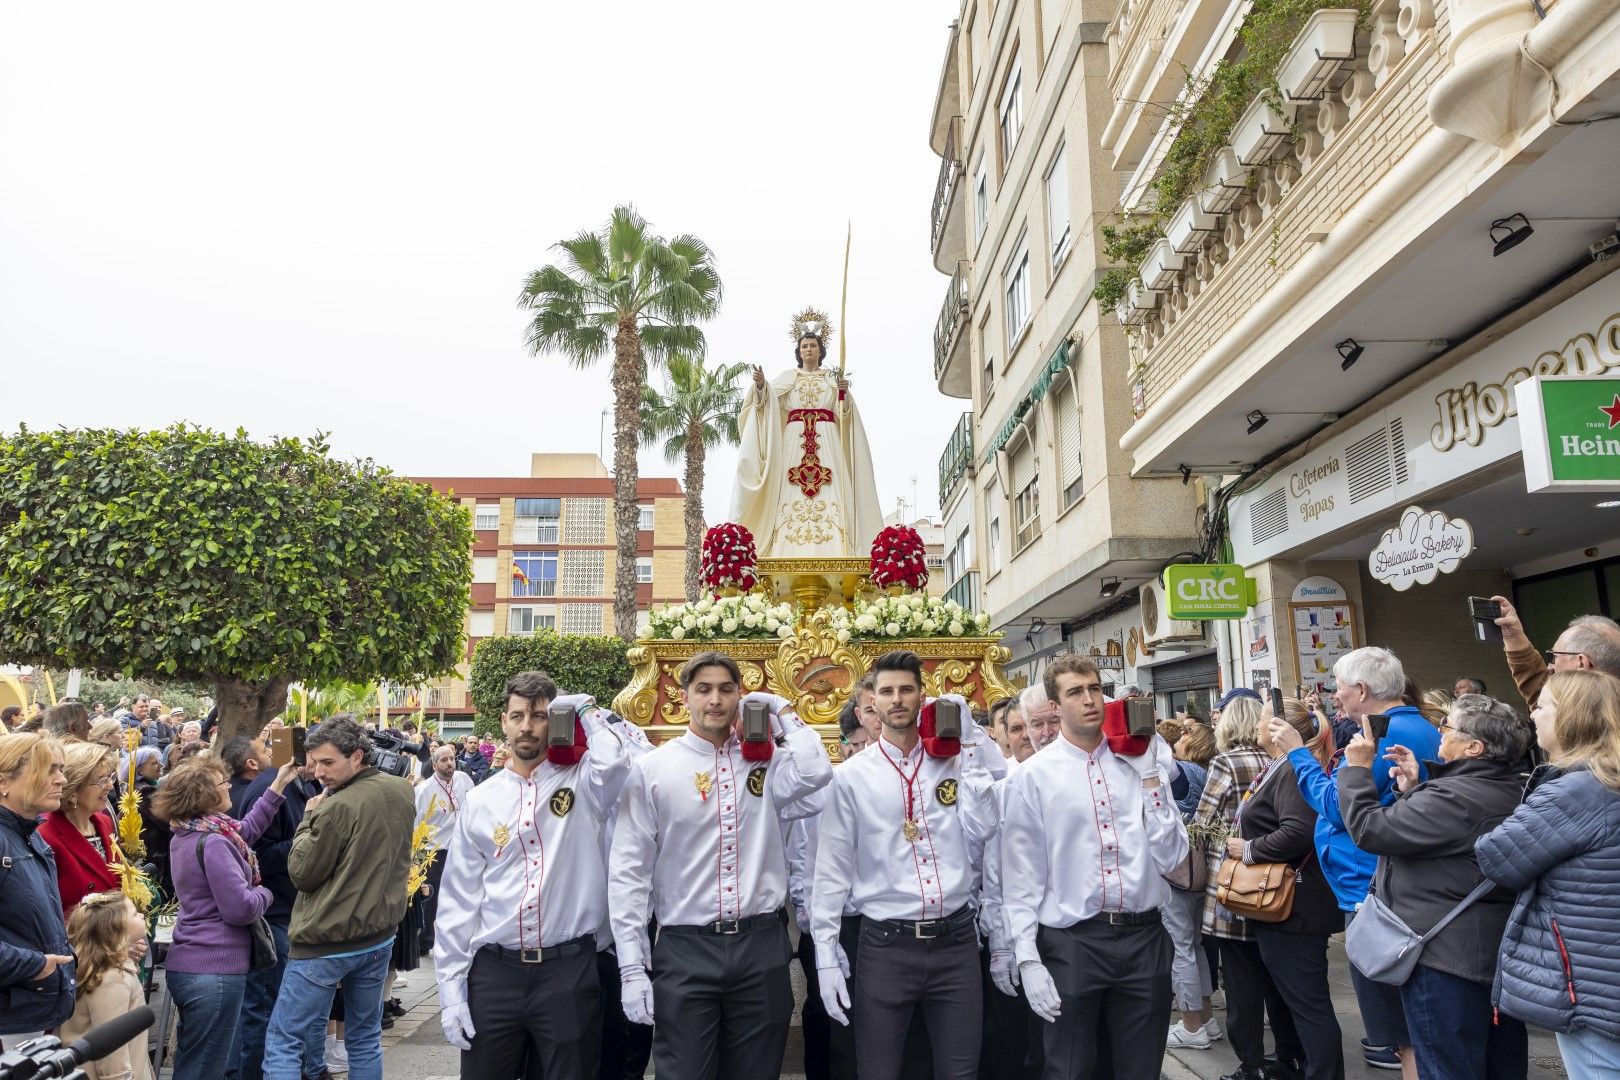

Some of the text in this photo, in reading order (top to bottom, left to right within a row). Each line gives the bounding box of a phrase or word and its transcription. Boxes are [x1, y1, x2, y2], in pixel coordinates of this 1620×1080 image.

[1290, 456, 1340, 498] Cafetería
[1300, 496, 1335, 522] Tapas
[1376, 535, 1464, 573] Delicious Bakery
[1403, 562, 1434, 576] La Ermita
[1177, 577, 1239, 601] CRC
